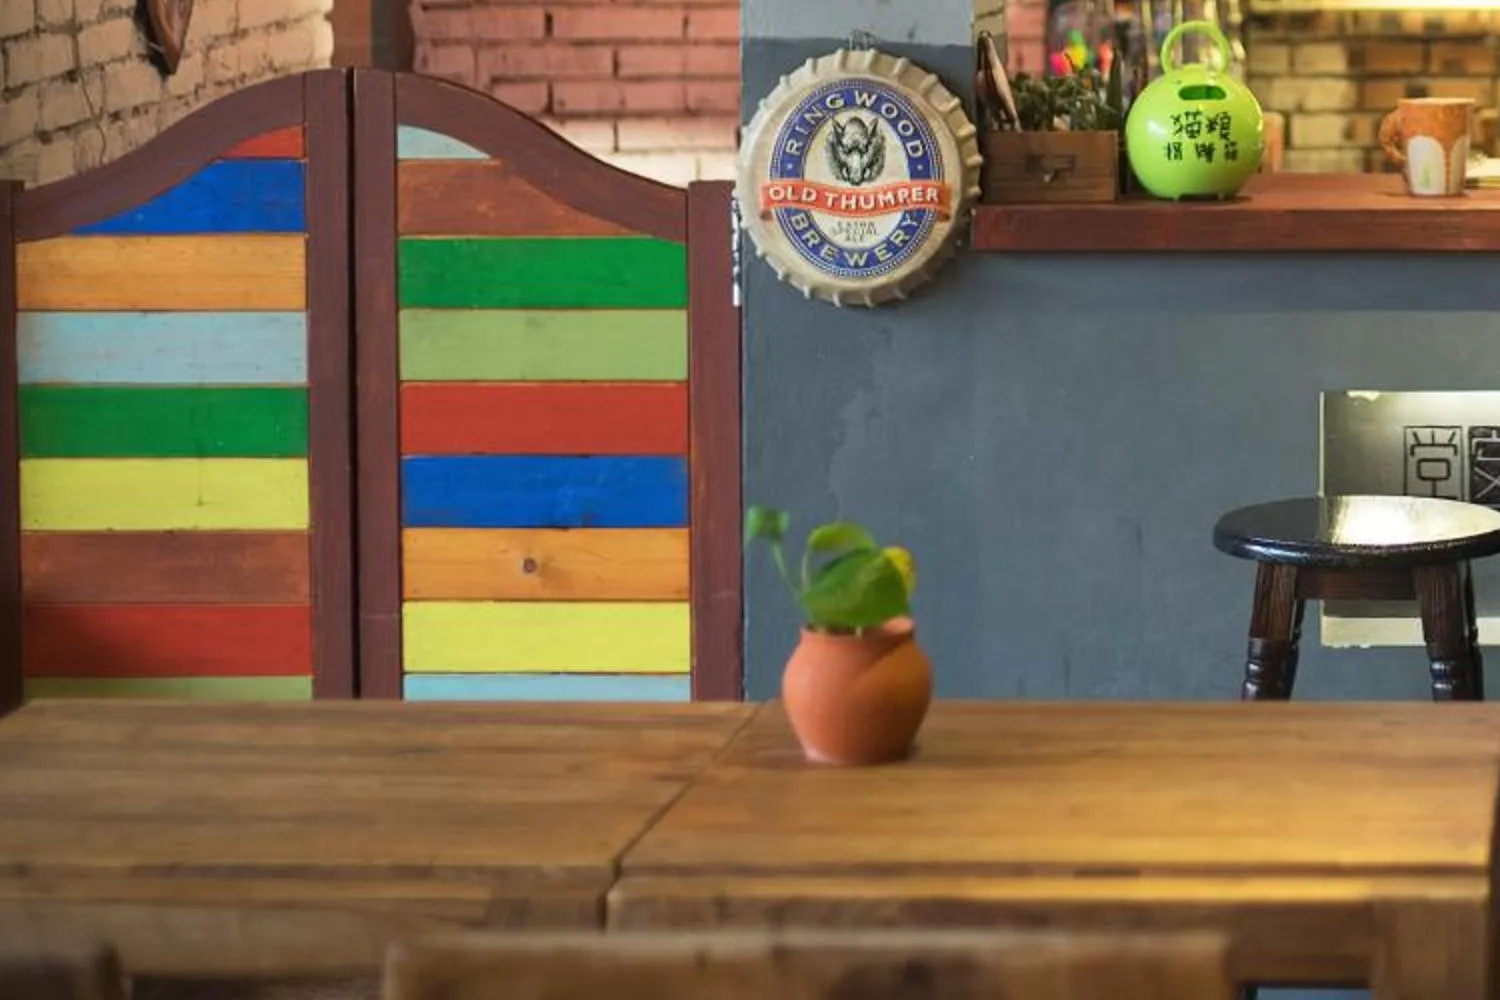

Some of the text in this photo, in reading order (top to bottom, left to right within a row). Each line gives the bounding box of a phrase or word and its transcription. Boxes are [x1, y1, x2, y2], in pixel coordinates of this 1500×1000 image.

[785, 89, 926, 157] RINGWOOD
[768, 185, 939, 211] OLD THUMPER
[790, 212, 920, 267] BREWERY
